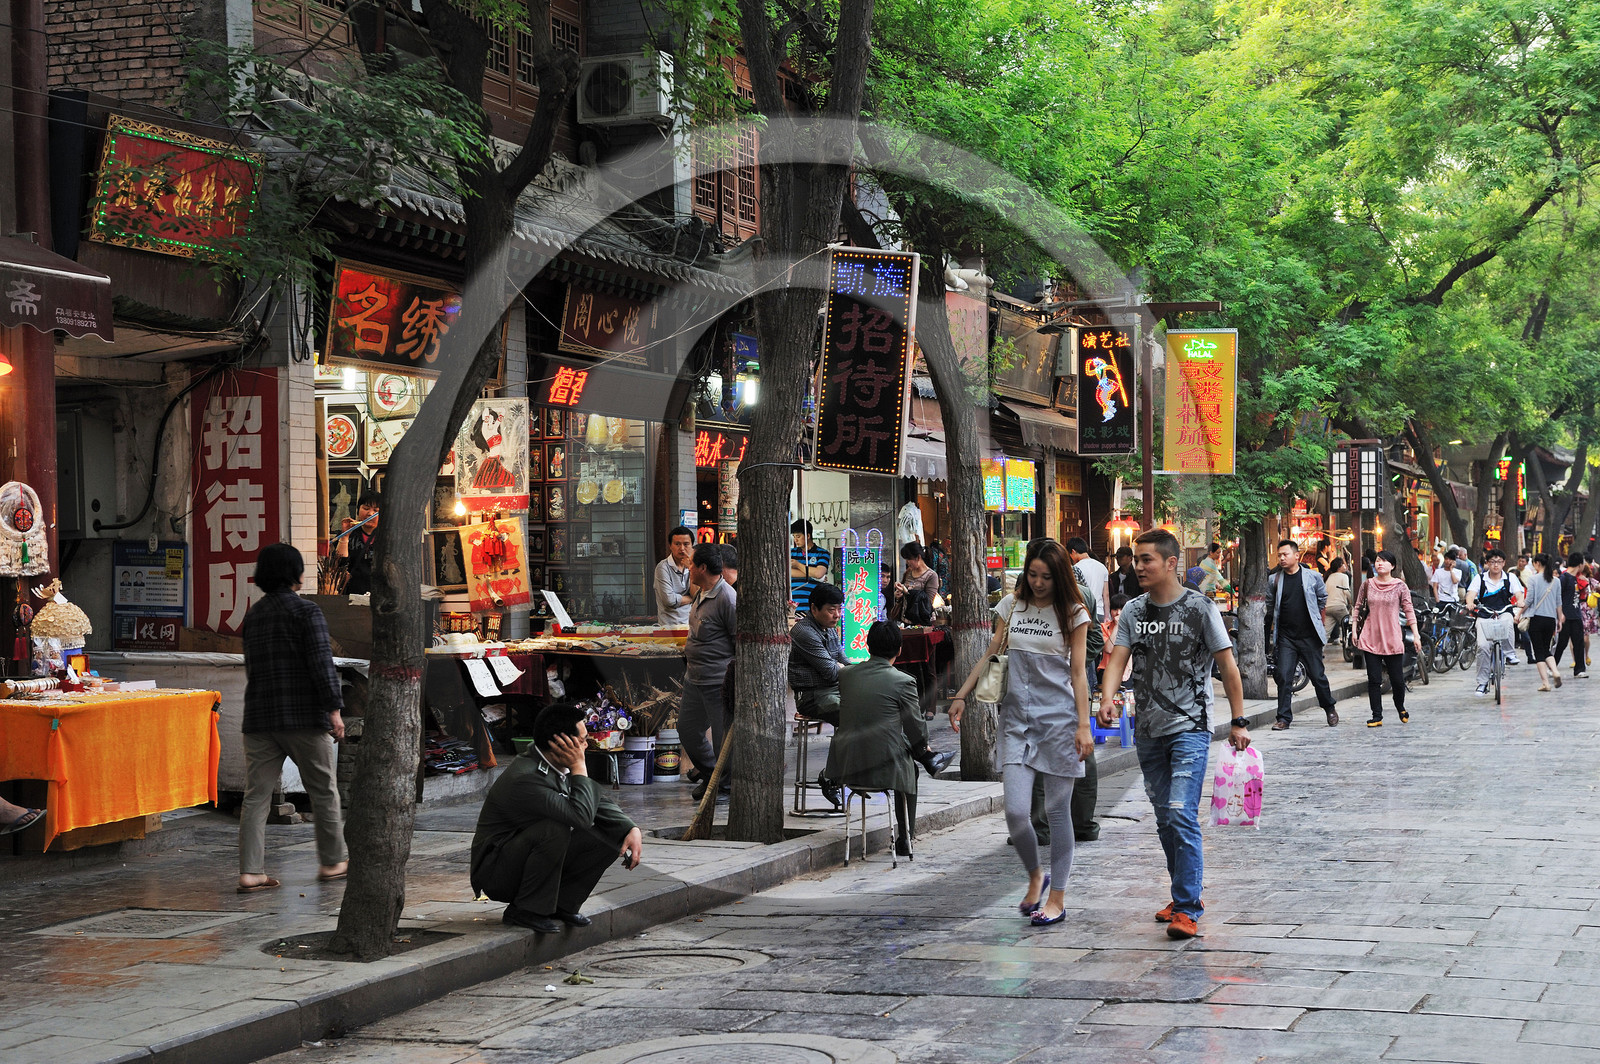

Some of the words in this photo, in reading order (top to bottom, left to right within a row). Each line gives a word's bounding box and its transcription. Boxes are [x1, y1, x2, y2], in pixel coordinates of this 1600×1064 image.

[836, 261, 905, 297] 凯旋
[5, 278, 42, 316] 斋
[339, 281, 449, 363] 名绣
[1082, 331, 1131, 349] 演艺社
[1187, 350, 1214, 359] HALAL
[825, 303, 896, 464] 招待所
[1082, 424, 1131, 441] 皮影戏
[203, 395, 266, 632] 招待所
[1009, 625, 1054, 638] SOMETHING
[1016, 617, 1051, 630] ALWAYS
[1134, 621, 1166, 635] STOP
[1168, 621, 1185, 635] IT!
